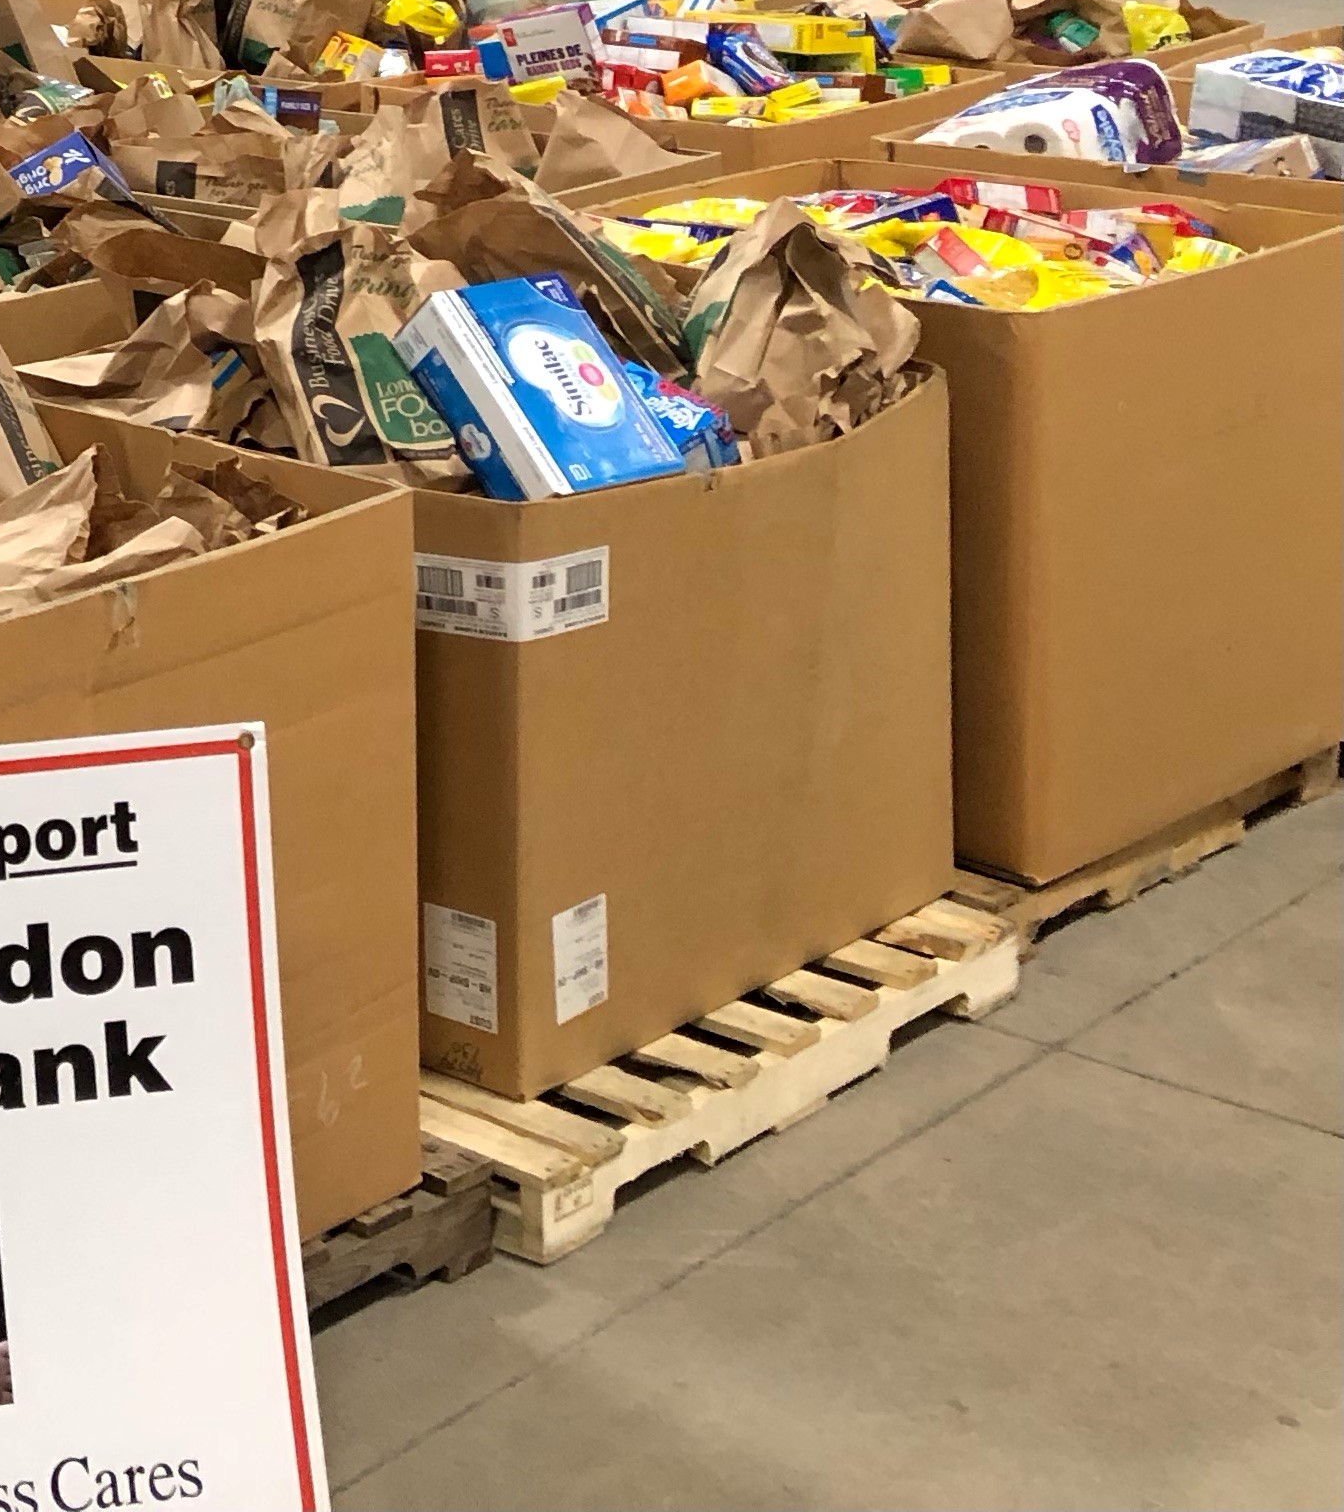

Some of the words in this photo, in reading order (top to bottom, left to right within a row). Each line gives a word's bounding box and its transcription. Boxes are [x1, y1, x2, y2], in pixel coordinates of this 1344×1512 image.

[515, 47, 566, 66] PLEINES
[565, 43, 584, 57] DE
[450, 107, 467, 149] Cares
[317, 275, 341, 326] Drive
[300, 306, 331, 389] Business
[320, 324, 346, 367] Food
[534, 338, 593, 418] Similac
[410, 420, 445, 438] ba
[48, 1456, 204, 1512] Cares
